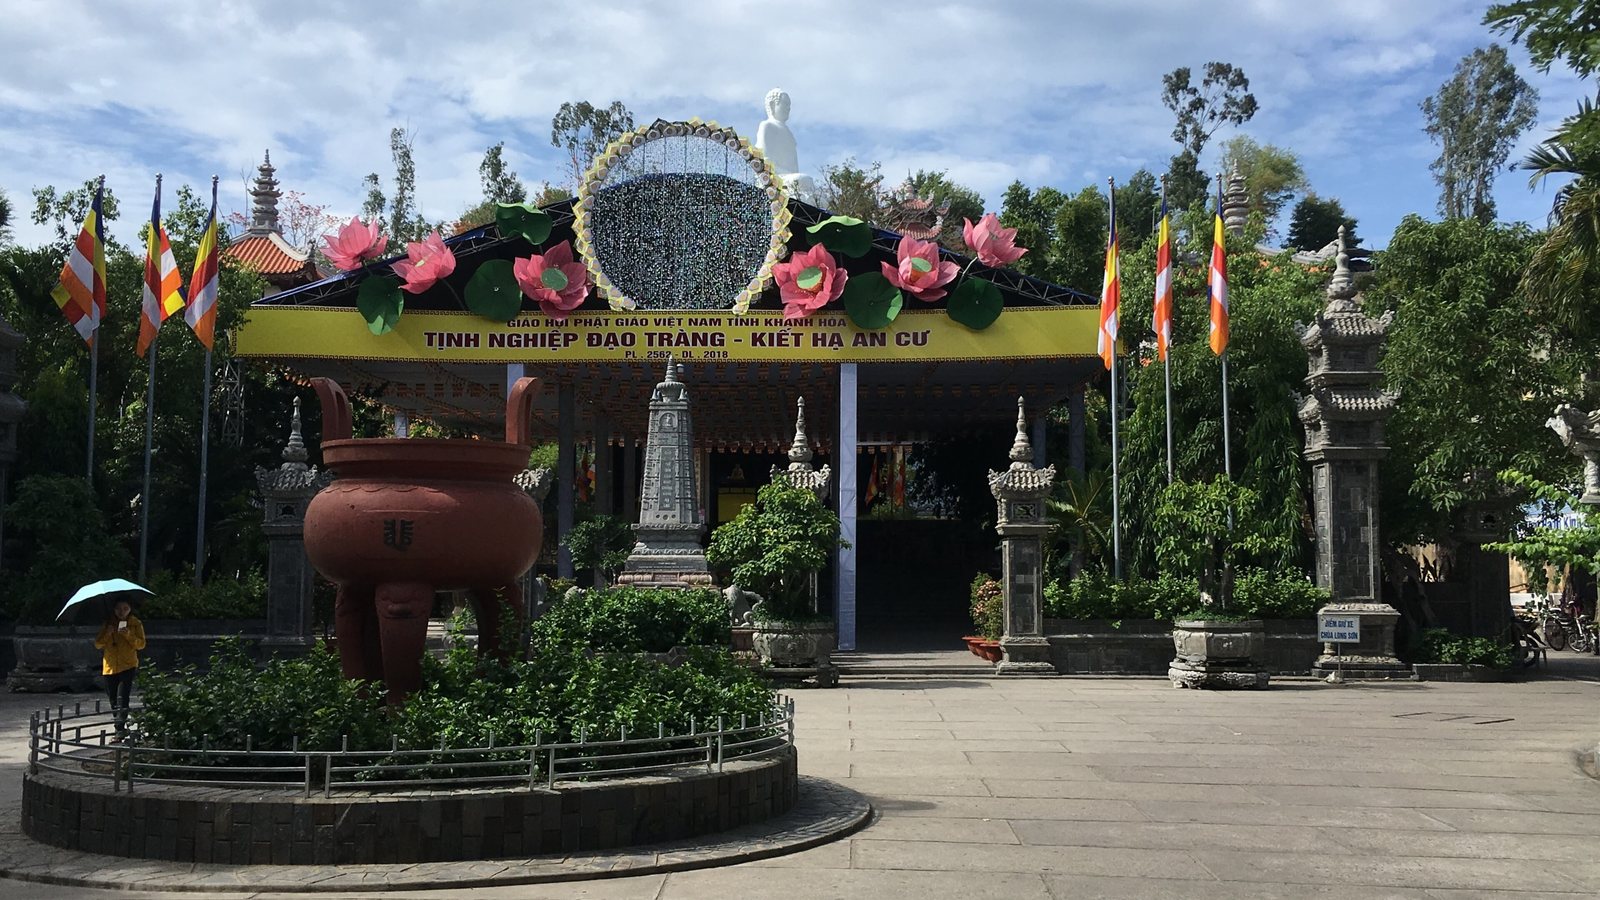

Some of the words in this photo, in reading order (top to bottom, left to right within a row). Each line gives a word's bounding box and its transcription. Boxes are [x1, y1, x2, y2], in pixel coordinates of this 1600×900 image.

[507, 317, 540, 328] GIÁO
[574, 316, 611, 329] PHẬT
[615, 316, 649, 327] GIÁO
[654, 316, 684, 328] VIỆT
[688, 318, 722, 327] NAM
[424, 332, 480, 351] TỊNH
[488, 329, 579, 351] NGHIỆP
[586, 332, 636, 351] ĐẠO
[644, 328, 725, 347] TRÀNG
[751, 327, 804, 347] KIẾT
[812, 332, 844, 351] HẠ
[852, 332, 887, 347] AN
[895, 330, 931, 347] CƯ
[703, 350, 728, 359] 2018
